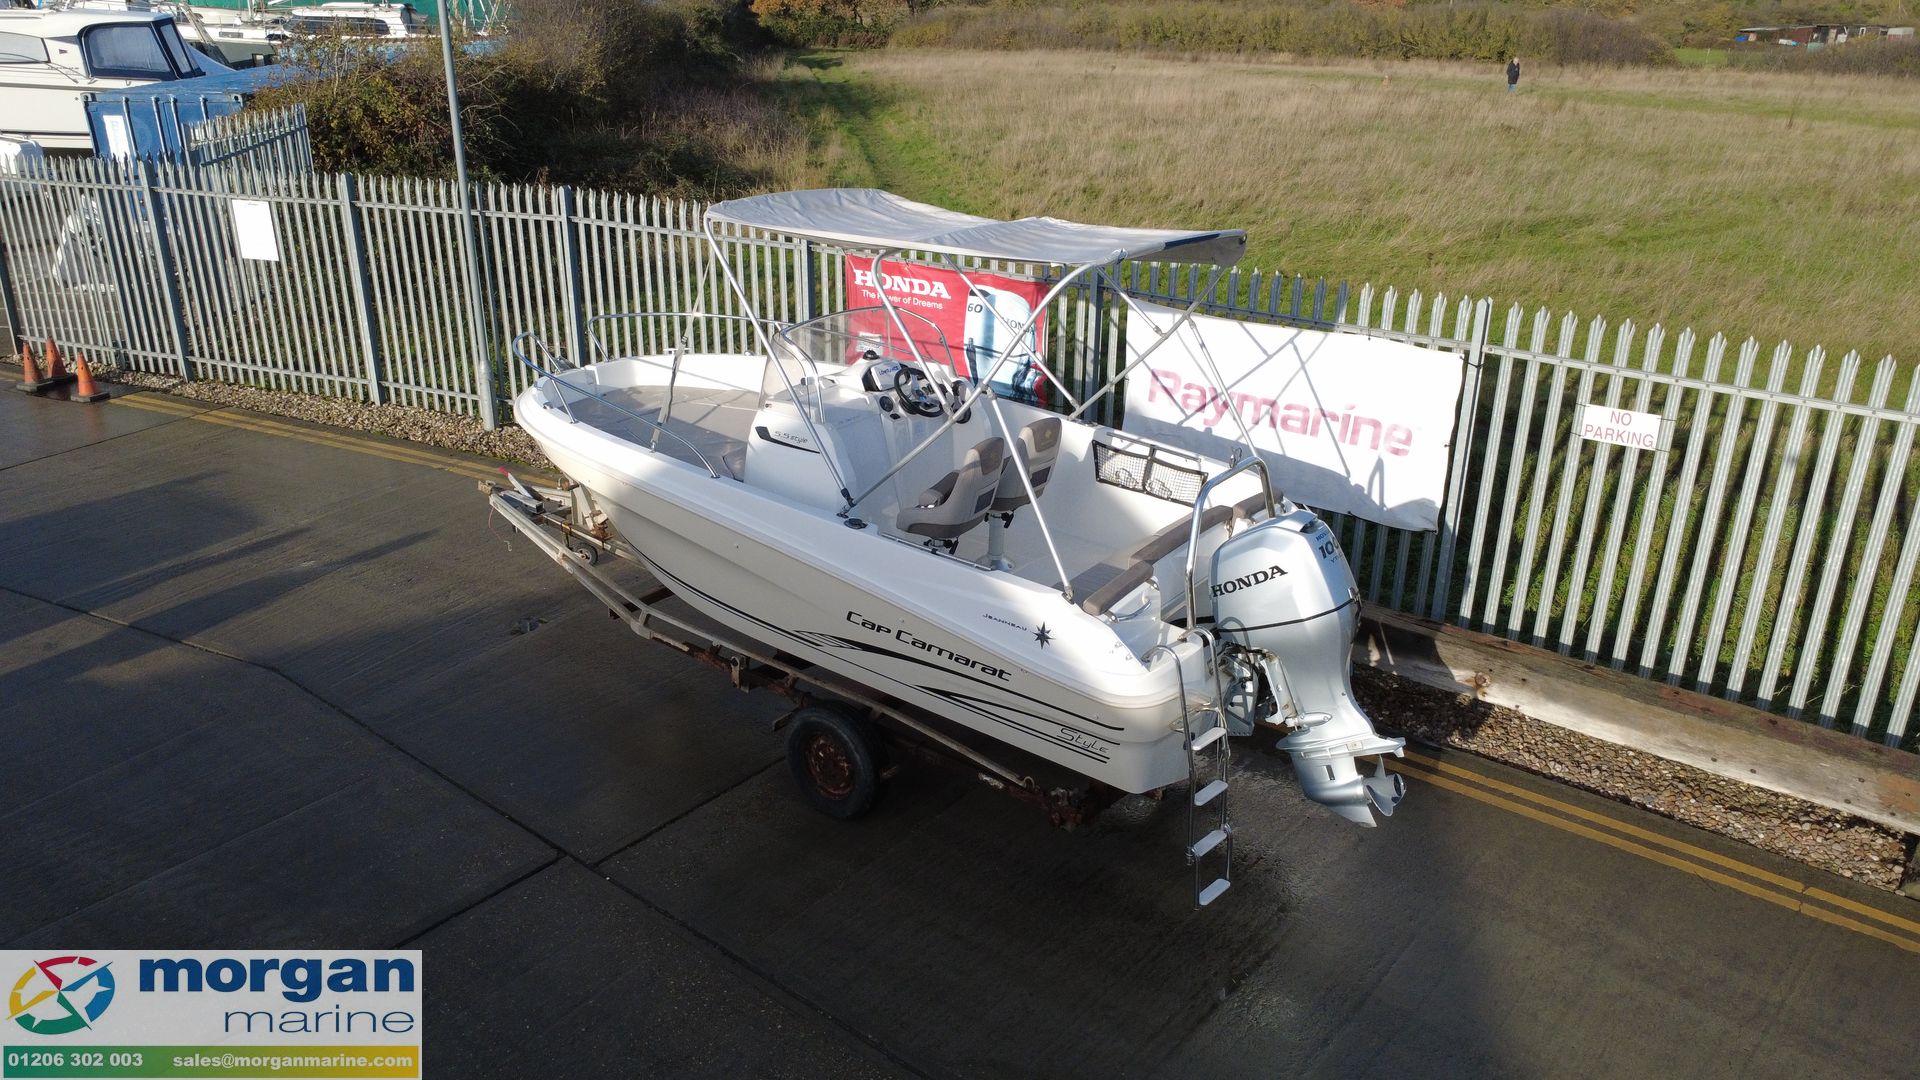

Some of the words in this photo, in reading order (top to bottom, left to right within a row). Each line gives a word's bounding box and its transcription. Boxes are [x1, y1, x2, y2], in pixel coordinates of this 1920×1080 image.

[854, 269, 952, 300] HONDA
[862, 289, 876, 299] The
[903, 296, 912, 305] of
[913, 297, 943, 309] Dreams
[967, 303, 983, 313] 60
[1148, 368, 1413, 457] Raymarine
[1610, 410, 1632, 426] NO
[1584, 423, 1655, 448] PARKING
[1210, 565, 1289, 598] HONDA
[982, 613, 1028, 632] JEANNEAU
[846, 610, 892, 634] Cap
[895, 629, 1013, 682] Camarat
[1057, 727, 1109, 753] Style
